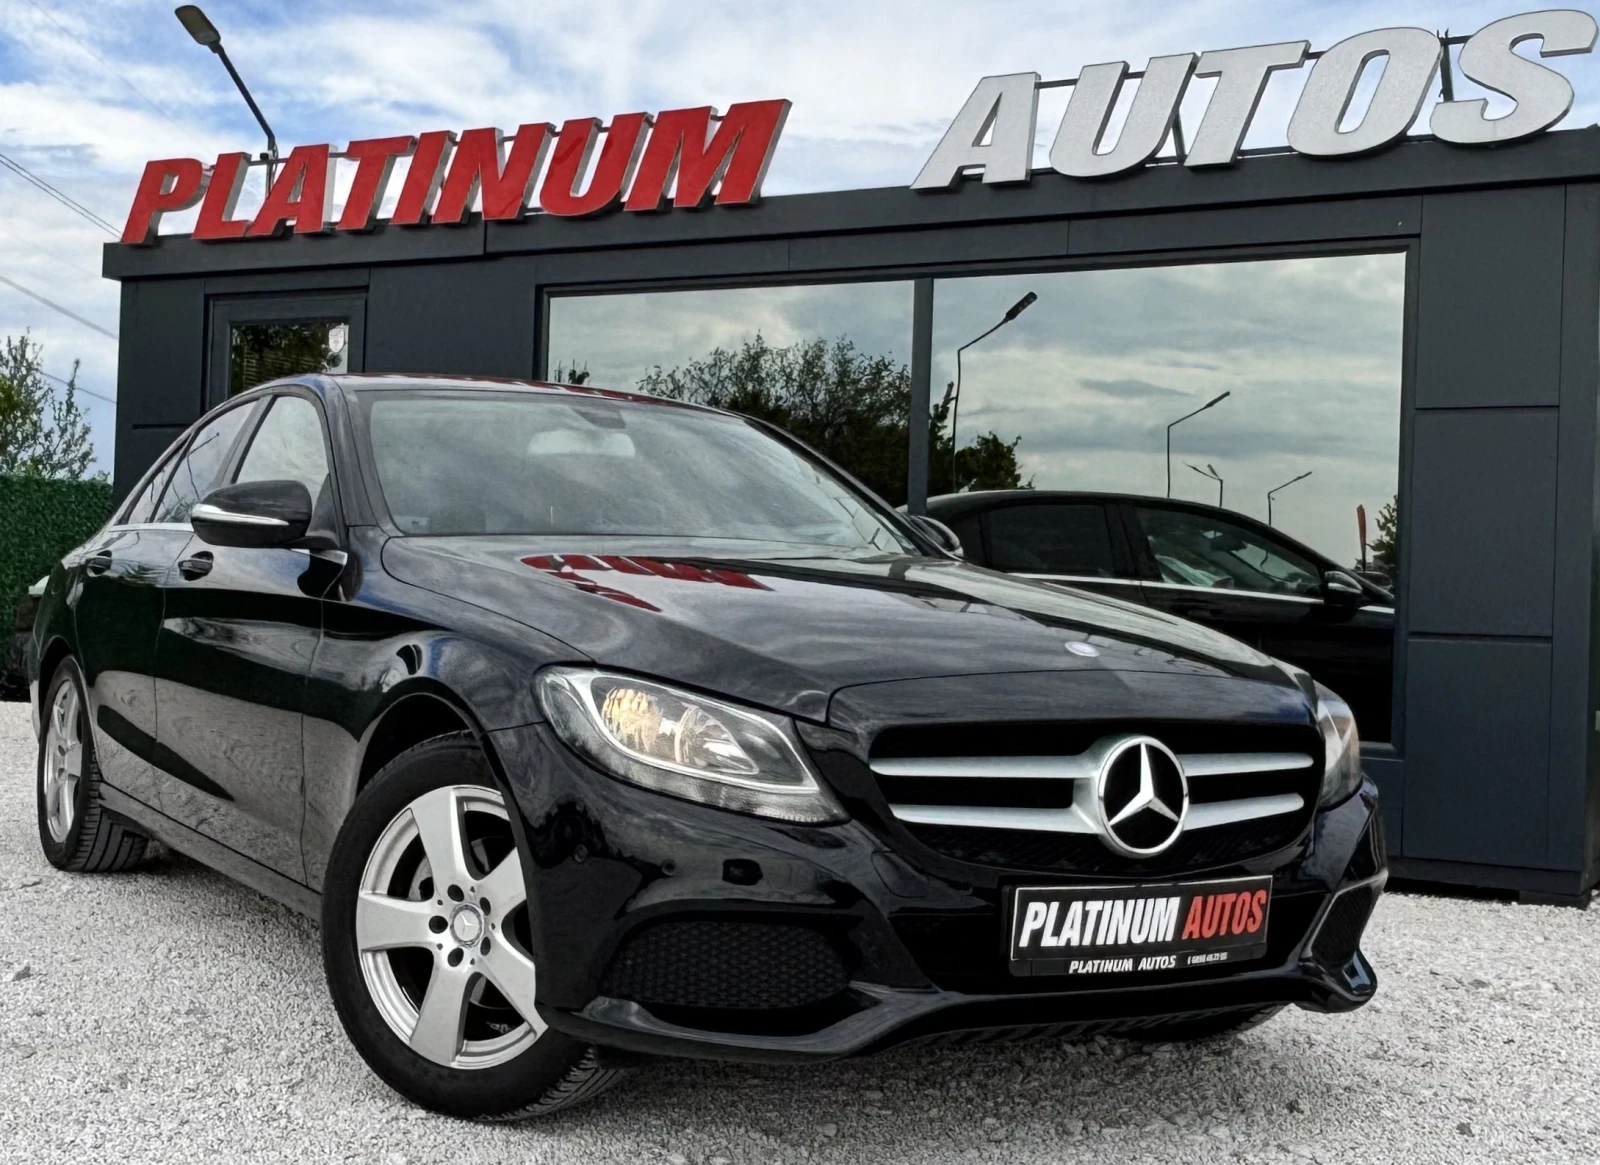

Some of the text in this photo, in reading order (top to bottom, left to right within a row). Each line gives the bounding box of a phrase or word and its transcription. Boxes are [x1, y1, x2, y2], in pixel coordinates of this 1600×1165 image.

[120, 8, 1598, 246] PLATINUM AUTOS
[1018, 889, 1268, 948] PLATINUM AUTOS
[1068, 957, 1134, 974] PLATINUM
[1138, 955, 1177, 971] AUTOS
